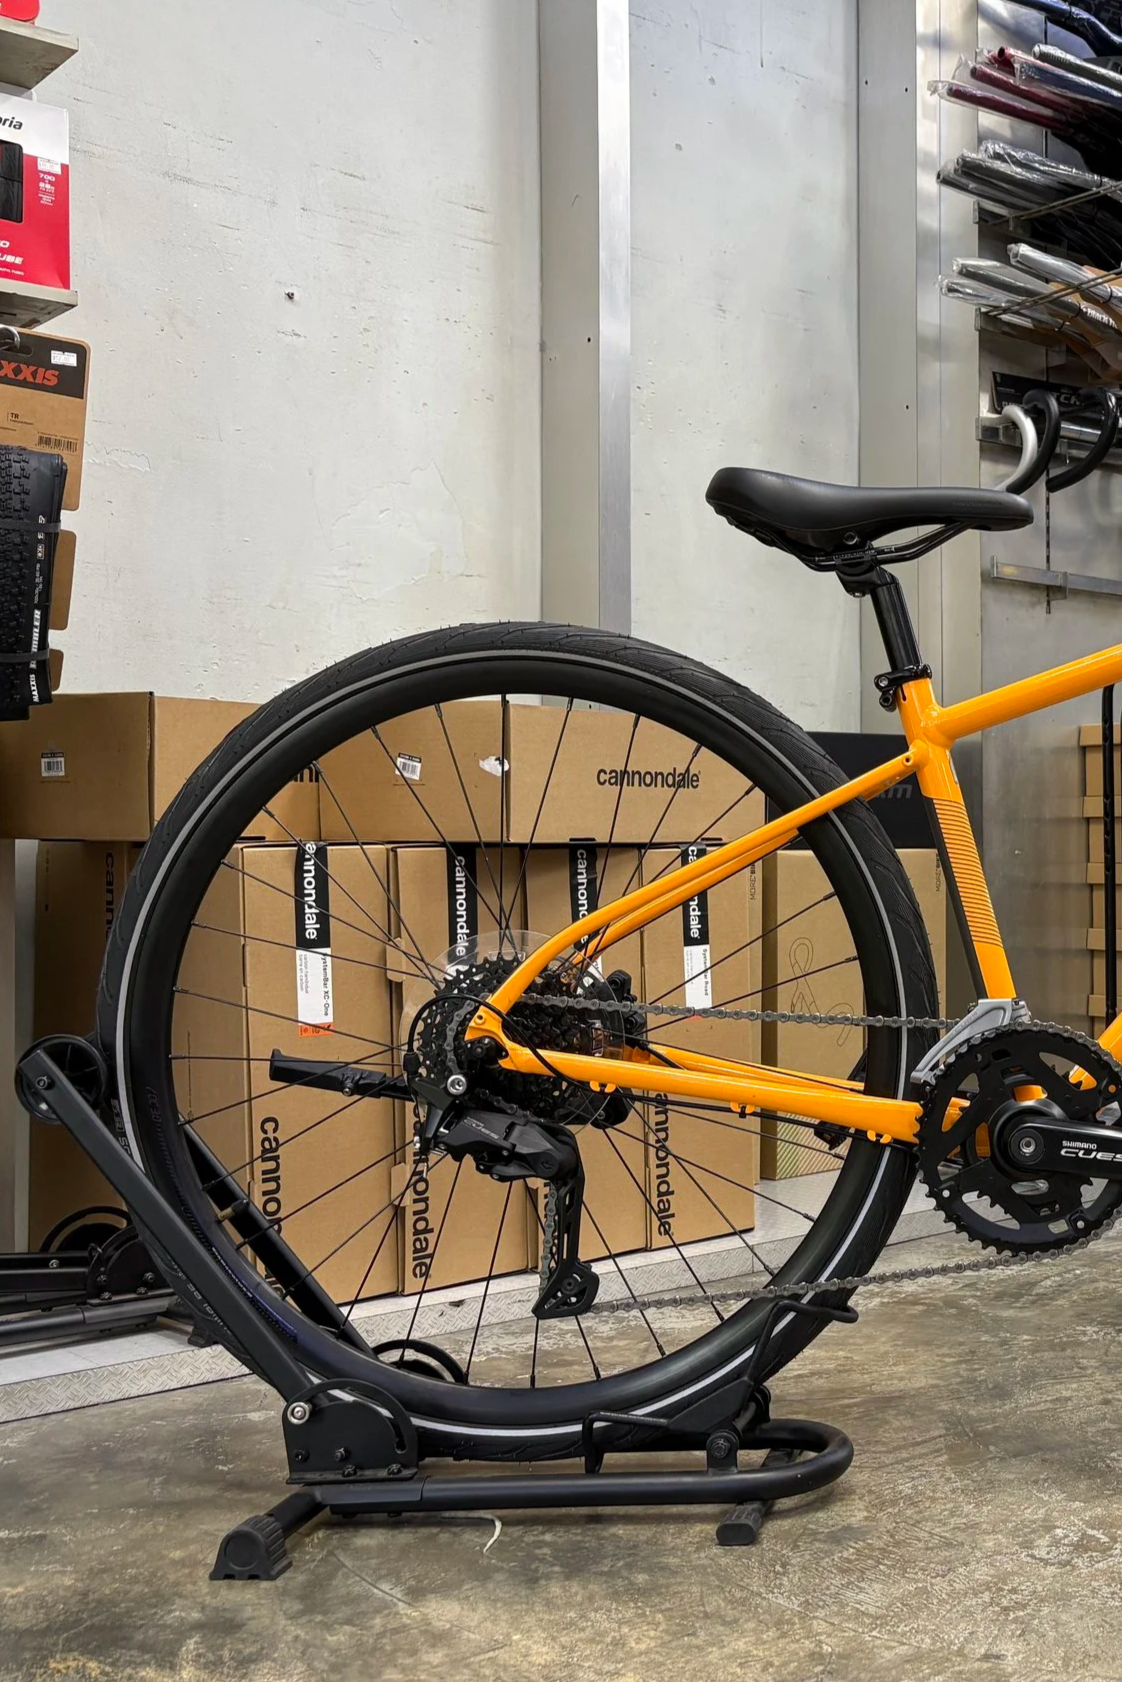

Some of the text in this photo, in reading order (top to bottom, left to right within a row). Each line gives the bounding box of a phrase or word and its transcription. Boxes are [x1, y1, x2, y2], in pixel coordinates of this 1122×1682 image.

[0, 360, 60, 387] XXIS
[10, 412, 19, 420] TR
[29, 609, 41, 669] RMBLER
[29, 673, 40, 702] MAXXIS
[596, 767, 700, 789] cannondale
[303, 841, 320, 940] annondale
[688, 846, 702, 939] candale
[455, 856, 469, 957] cannondale
[322, 989, 330, 1017] XC-One
[1062, 1140, 1098, 1150] SHIMANO
[654, 1092, 676, 1236] annondale
